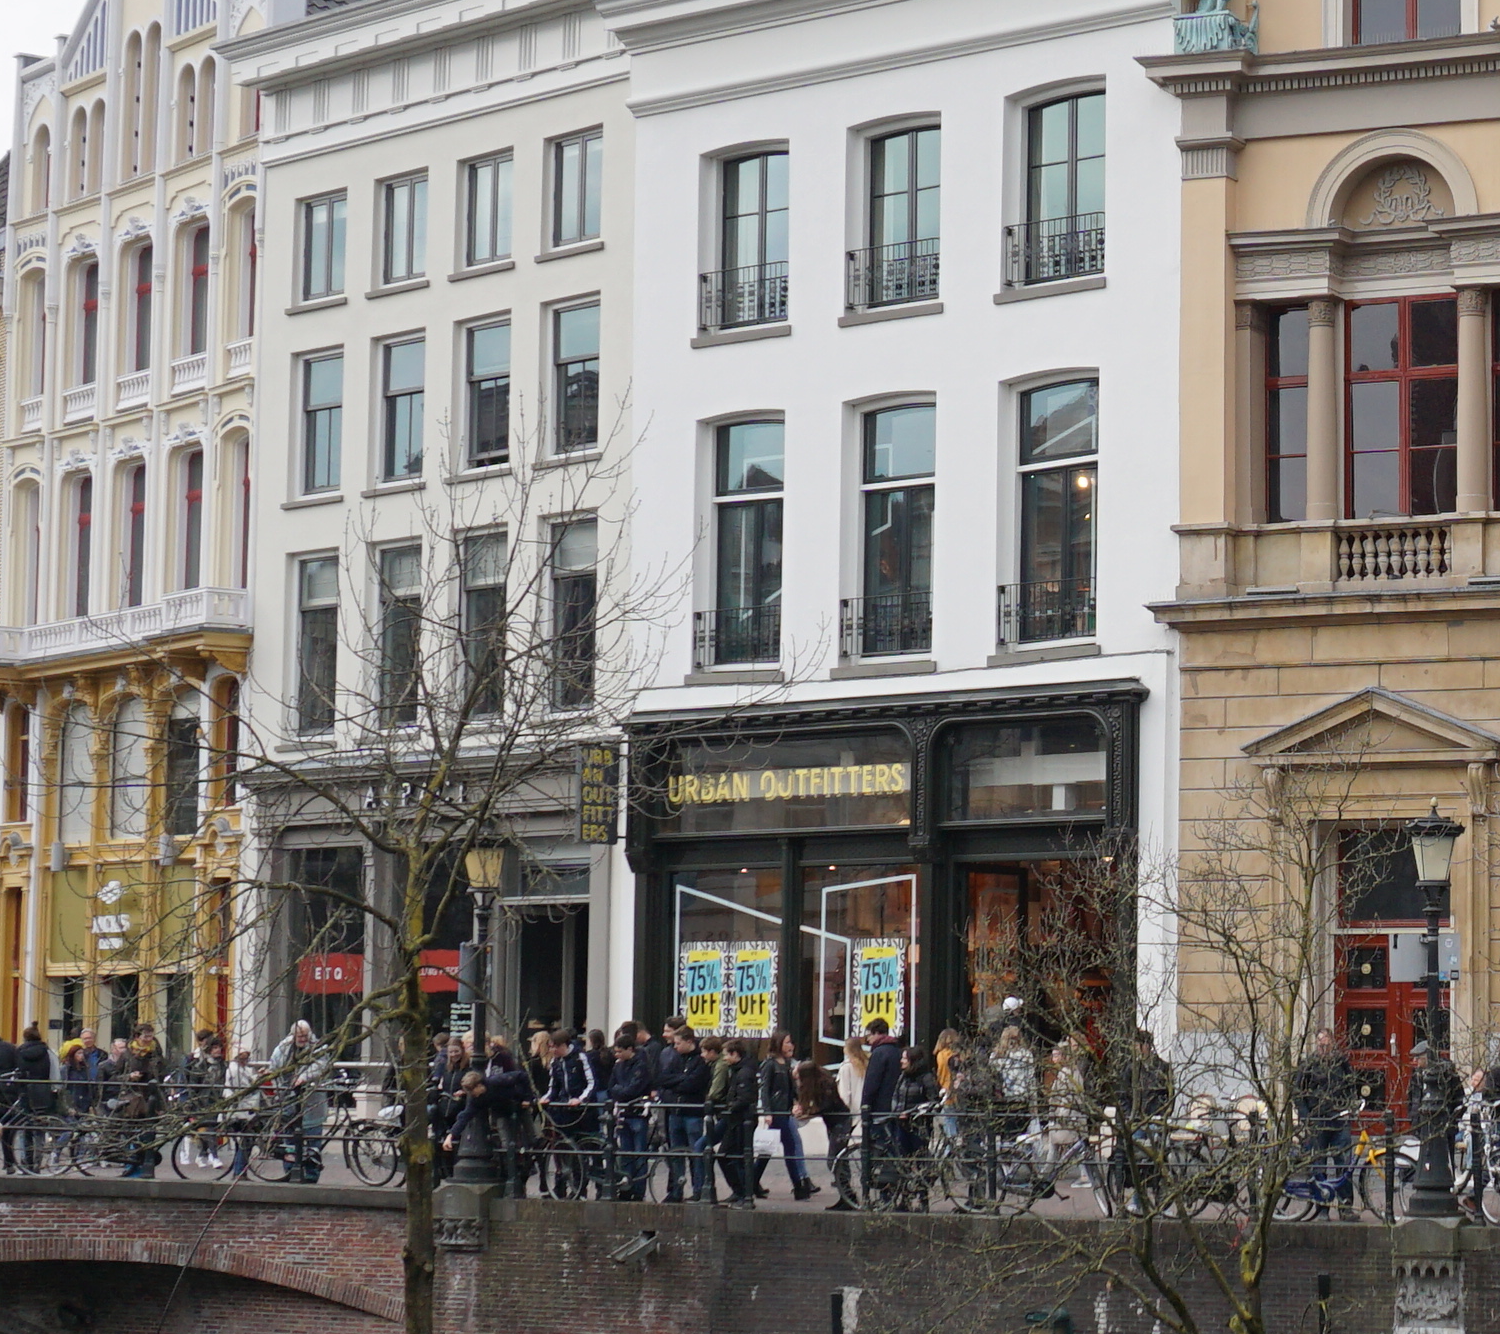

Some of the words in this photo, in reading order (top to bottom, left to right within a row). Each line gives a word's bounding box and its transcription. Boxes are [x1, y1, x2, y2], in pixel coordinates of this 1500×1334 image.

[668, 773, 750, 805] URBAN
[760, 763, 906, 801] OUTFITTERS
[582, 824, 609, 842] ERS
[686, 962, 718, 993] 75%
[736, 962, 768, 993] 75%
[862, 959, 894, 990] 75%
[689, 994, 717, 1015] OFF
[739, 994, 767, 1015] OFF
[865, 991, 893, 1012] OFF
